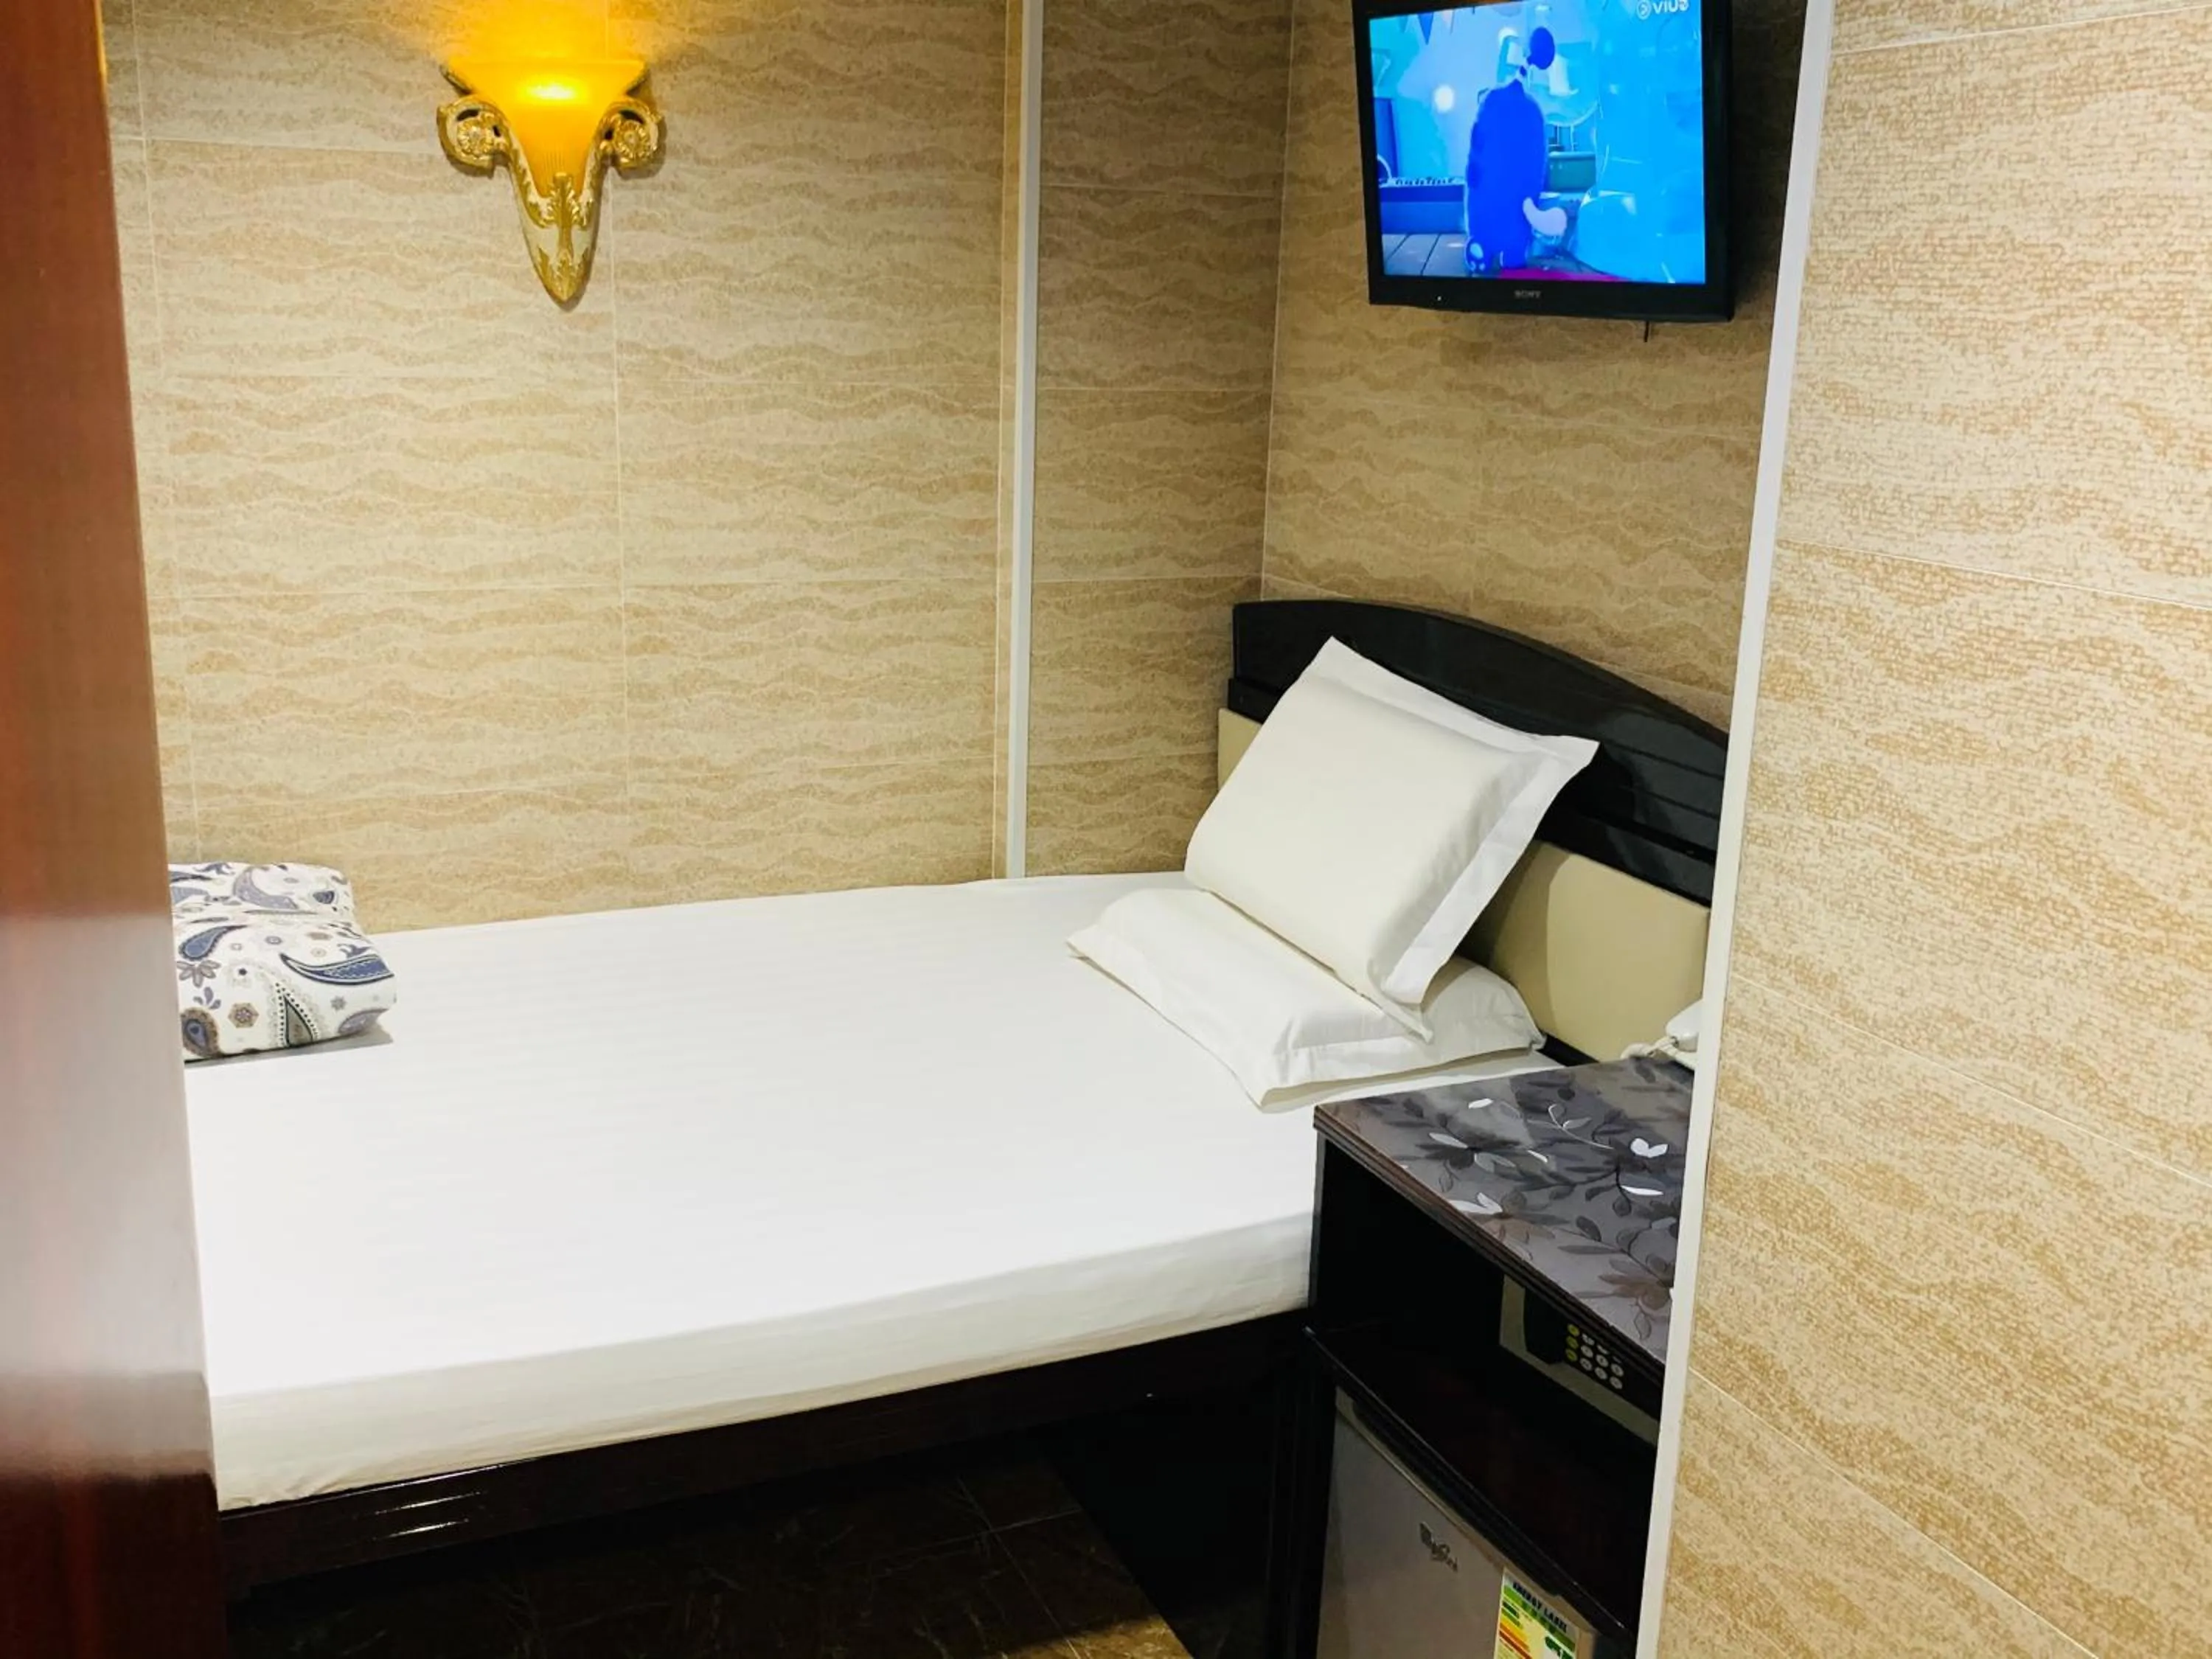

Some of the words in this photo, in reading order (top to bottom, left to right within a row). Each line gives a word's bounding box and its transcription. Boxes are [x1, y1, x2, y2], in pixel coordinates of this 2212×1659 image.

[1514, 290, 1541, 299] SONY
[1512, 1582, 1542, 1610] ENERGY
[1544, 1607, 1567, 1633] LABEL
